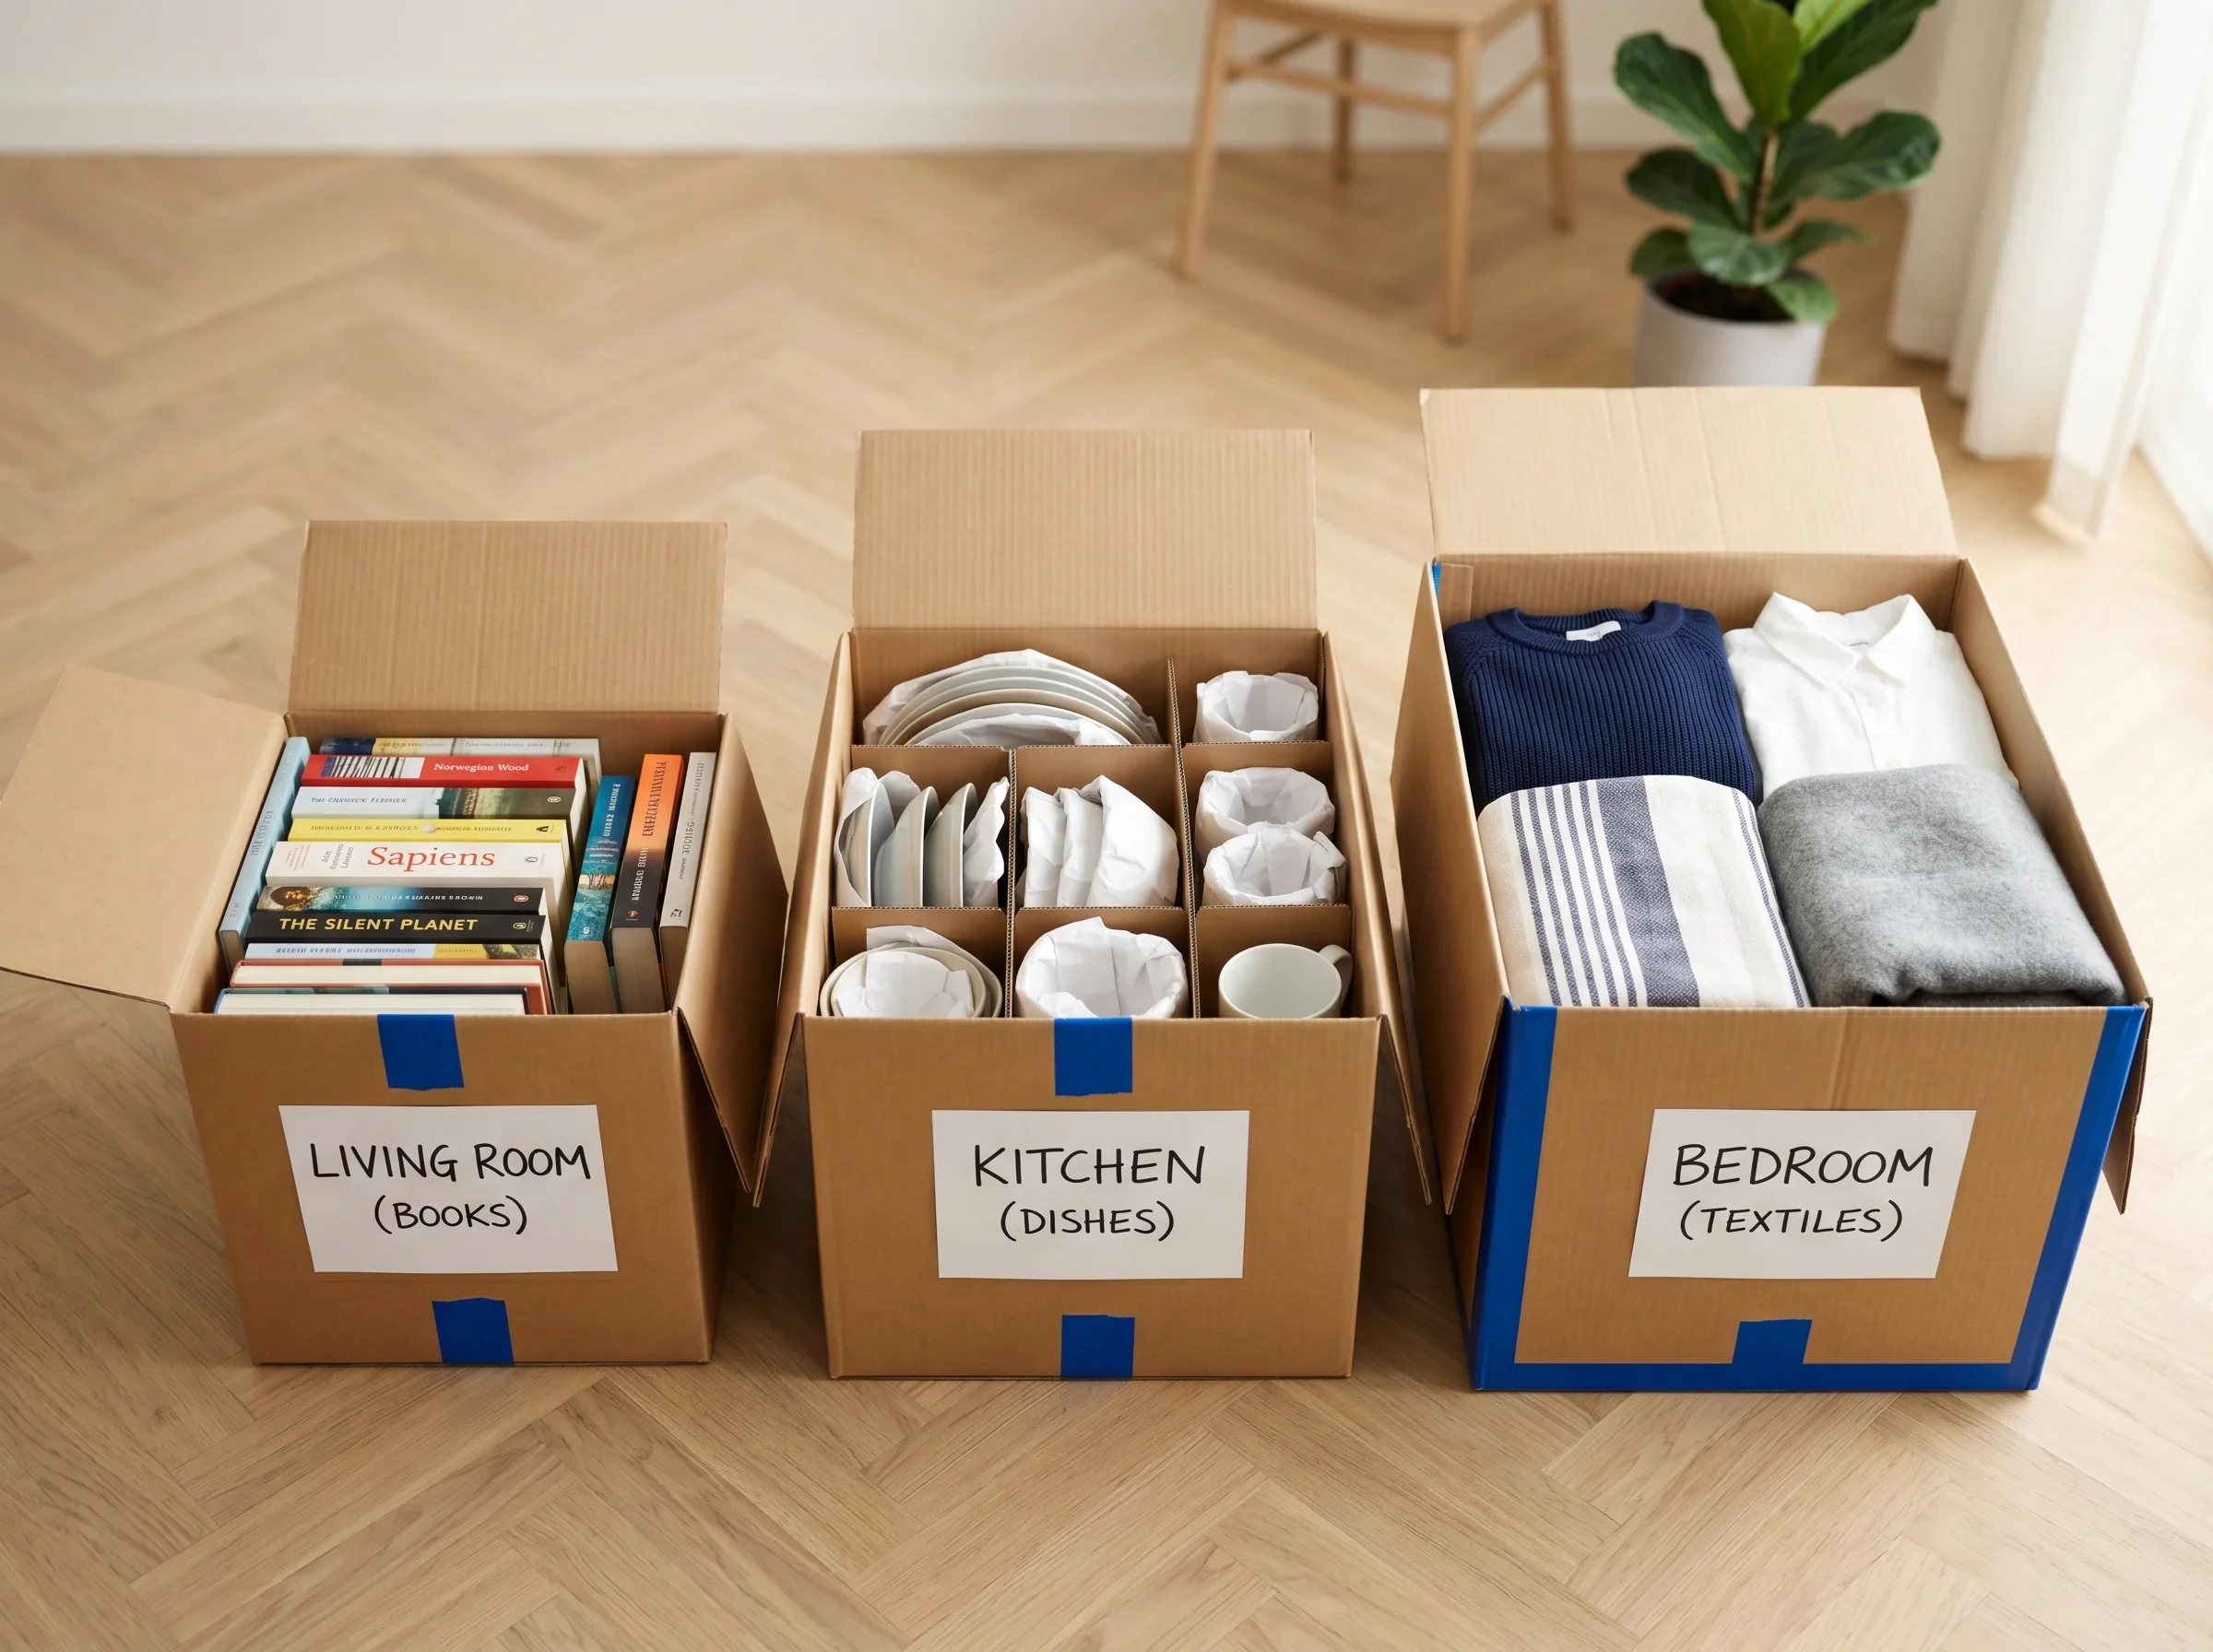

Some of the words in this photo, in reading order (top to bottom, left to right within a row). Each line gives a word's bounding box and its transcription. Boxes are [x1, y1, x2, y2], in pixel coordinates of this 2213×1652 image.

[433, 762, 494, 773] Norwegian
[497, 762, 529, 773] Wood
[367, 846, 496, 872] Sapiens
[279, 918, 317, 930] THE
[325, 917, 394, 931] SILENT
[400, 918, 479, 931] PLANET
[309, 1142, 459, 1183] LIVING
[473, 1142, 591, 1181] ROOM
[974, 1144, 1206, 1187] KITCHEN
[1673, 1143, 1935, 1187] BEDROOM
[373, 1194, 528, 1235] (BOOKS)
[1000, 1200, 1176, 1243] (DISHES)
[1679, 1199, 1904, 1243] (TEXTILES)
